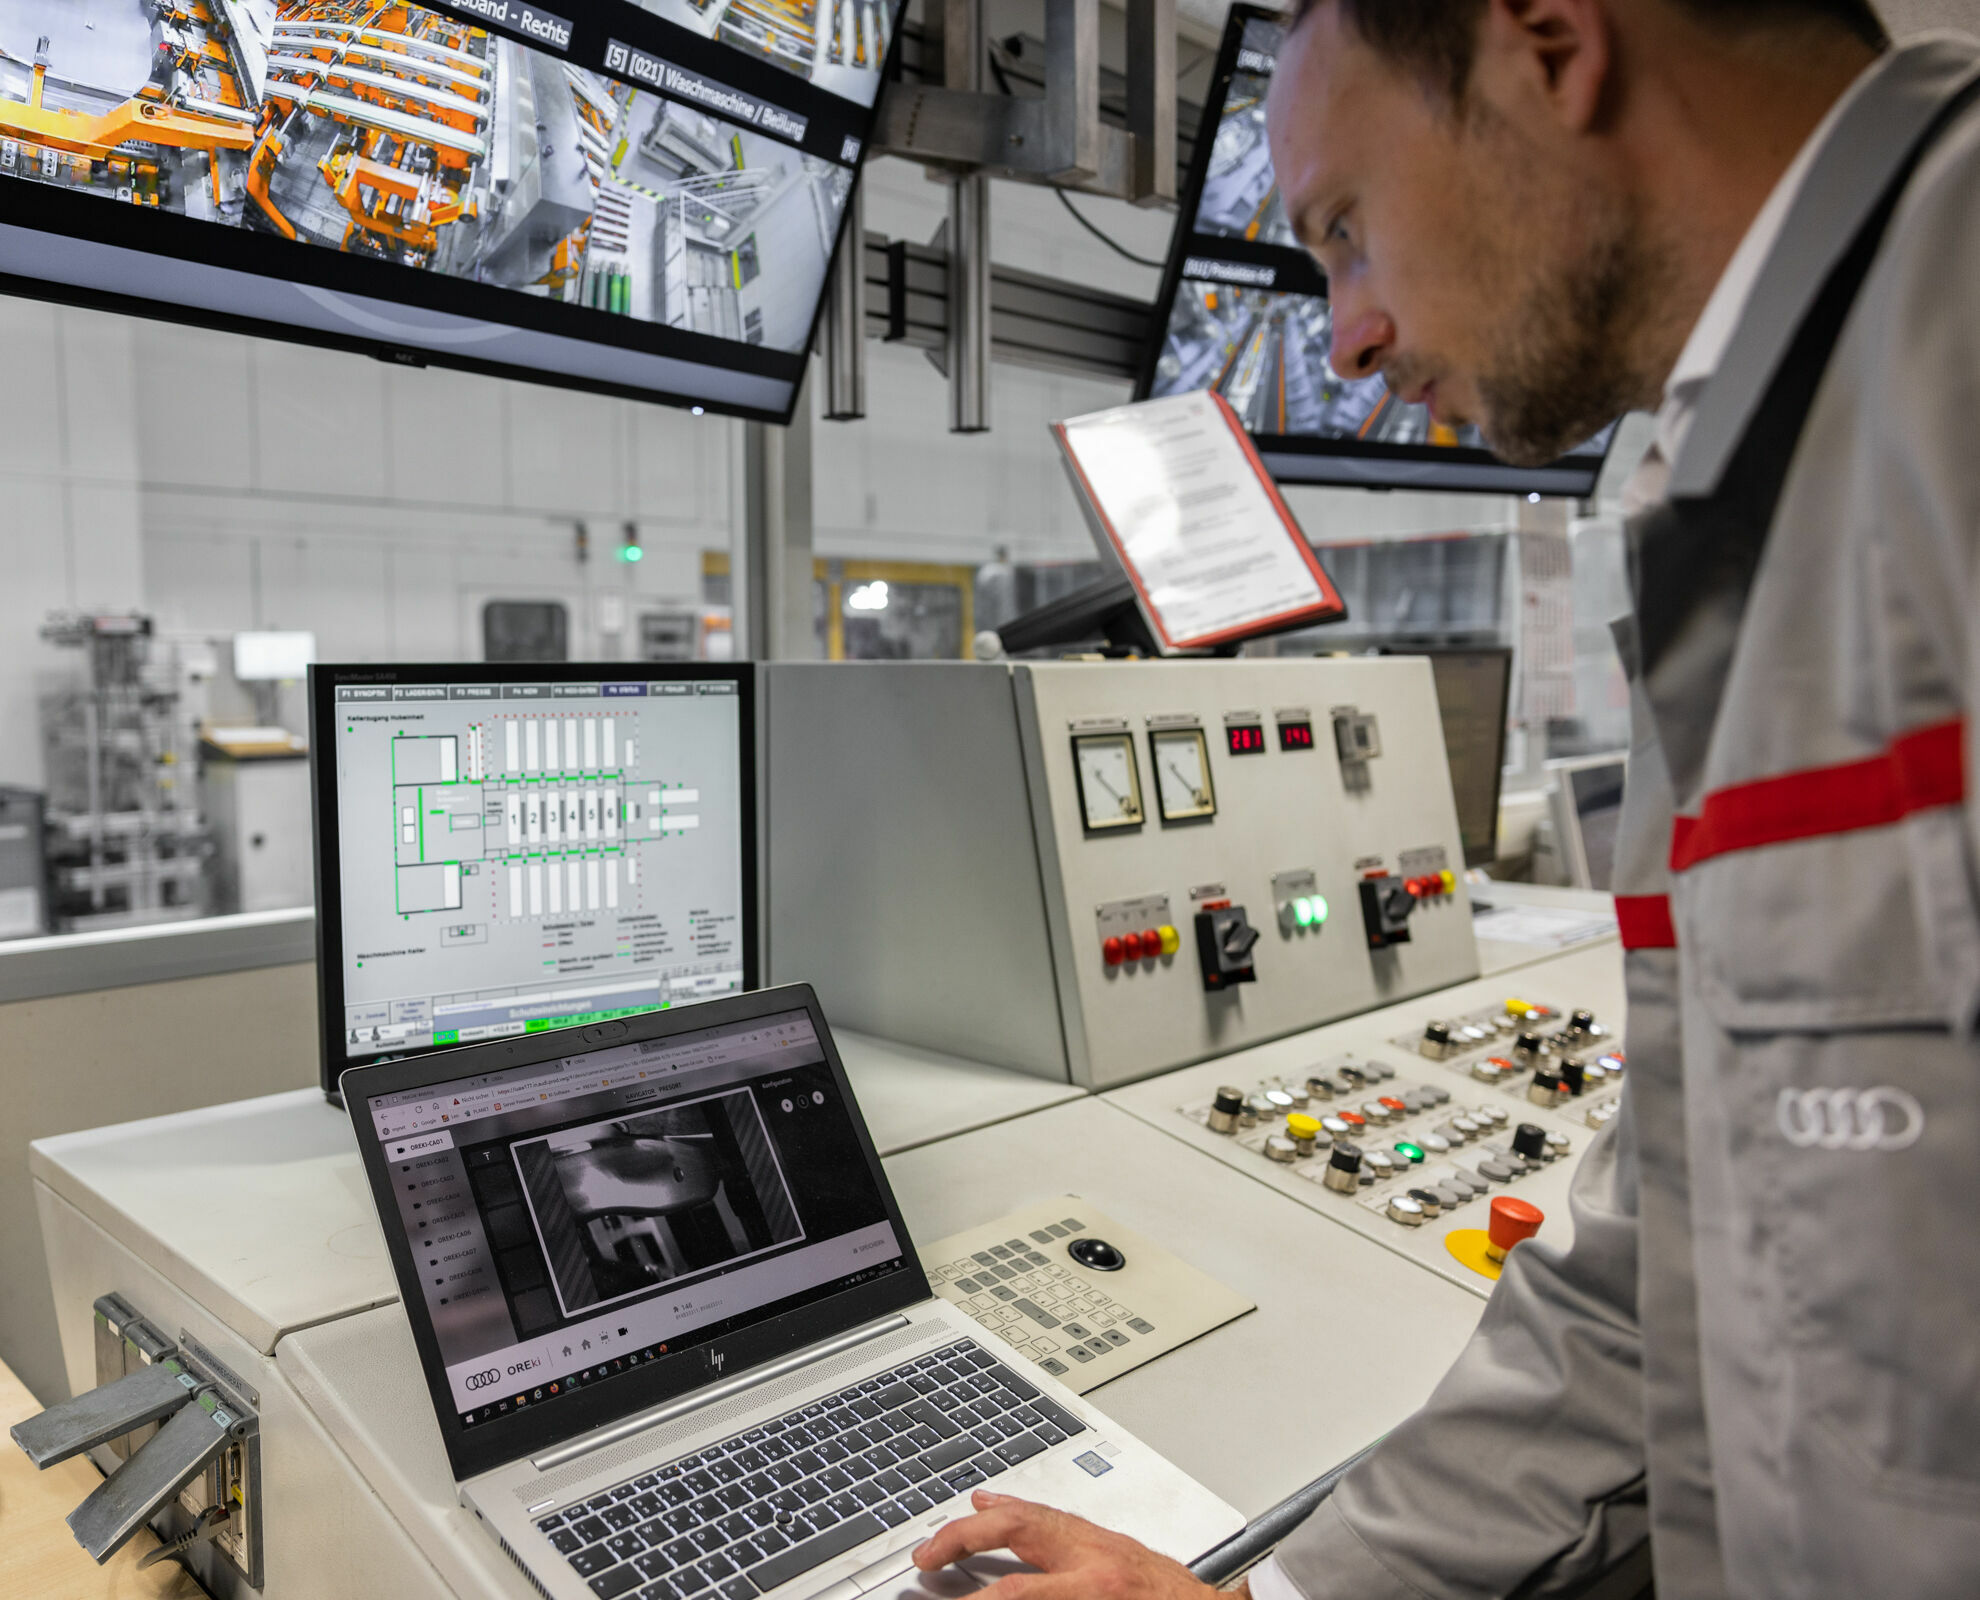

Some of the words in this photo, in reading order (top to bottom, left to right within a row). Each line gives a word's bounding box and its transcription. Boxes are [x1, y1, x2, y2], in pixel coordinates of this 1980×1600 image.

[520, 10, 570, 46] Rechts
[604, 44, 628, 71] [5]
[628, 49, 665, 87] [021]
[665, 67, 755, 120] Waschmaschine
[625, 1088, 655, 1100] NAVIGATOR
[658, 1082, 682, 1093] PRESORT
[410, 1138, 443, 1150] OREKI-CA01
[507, 1357, 542, 1377] OREki
